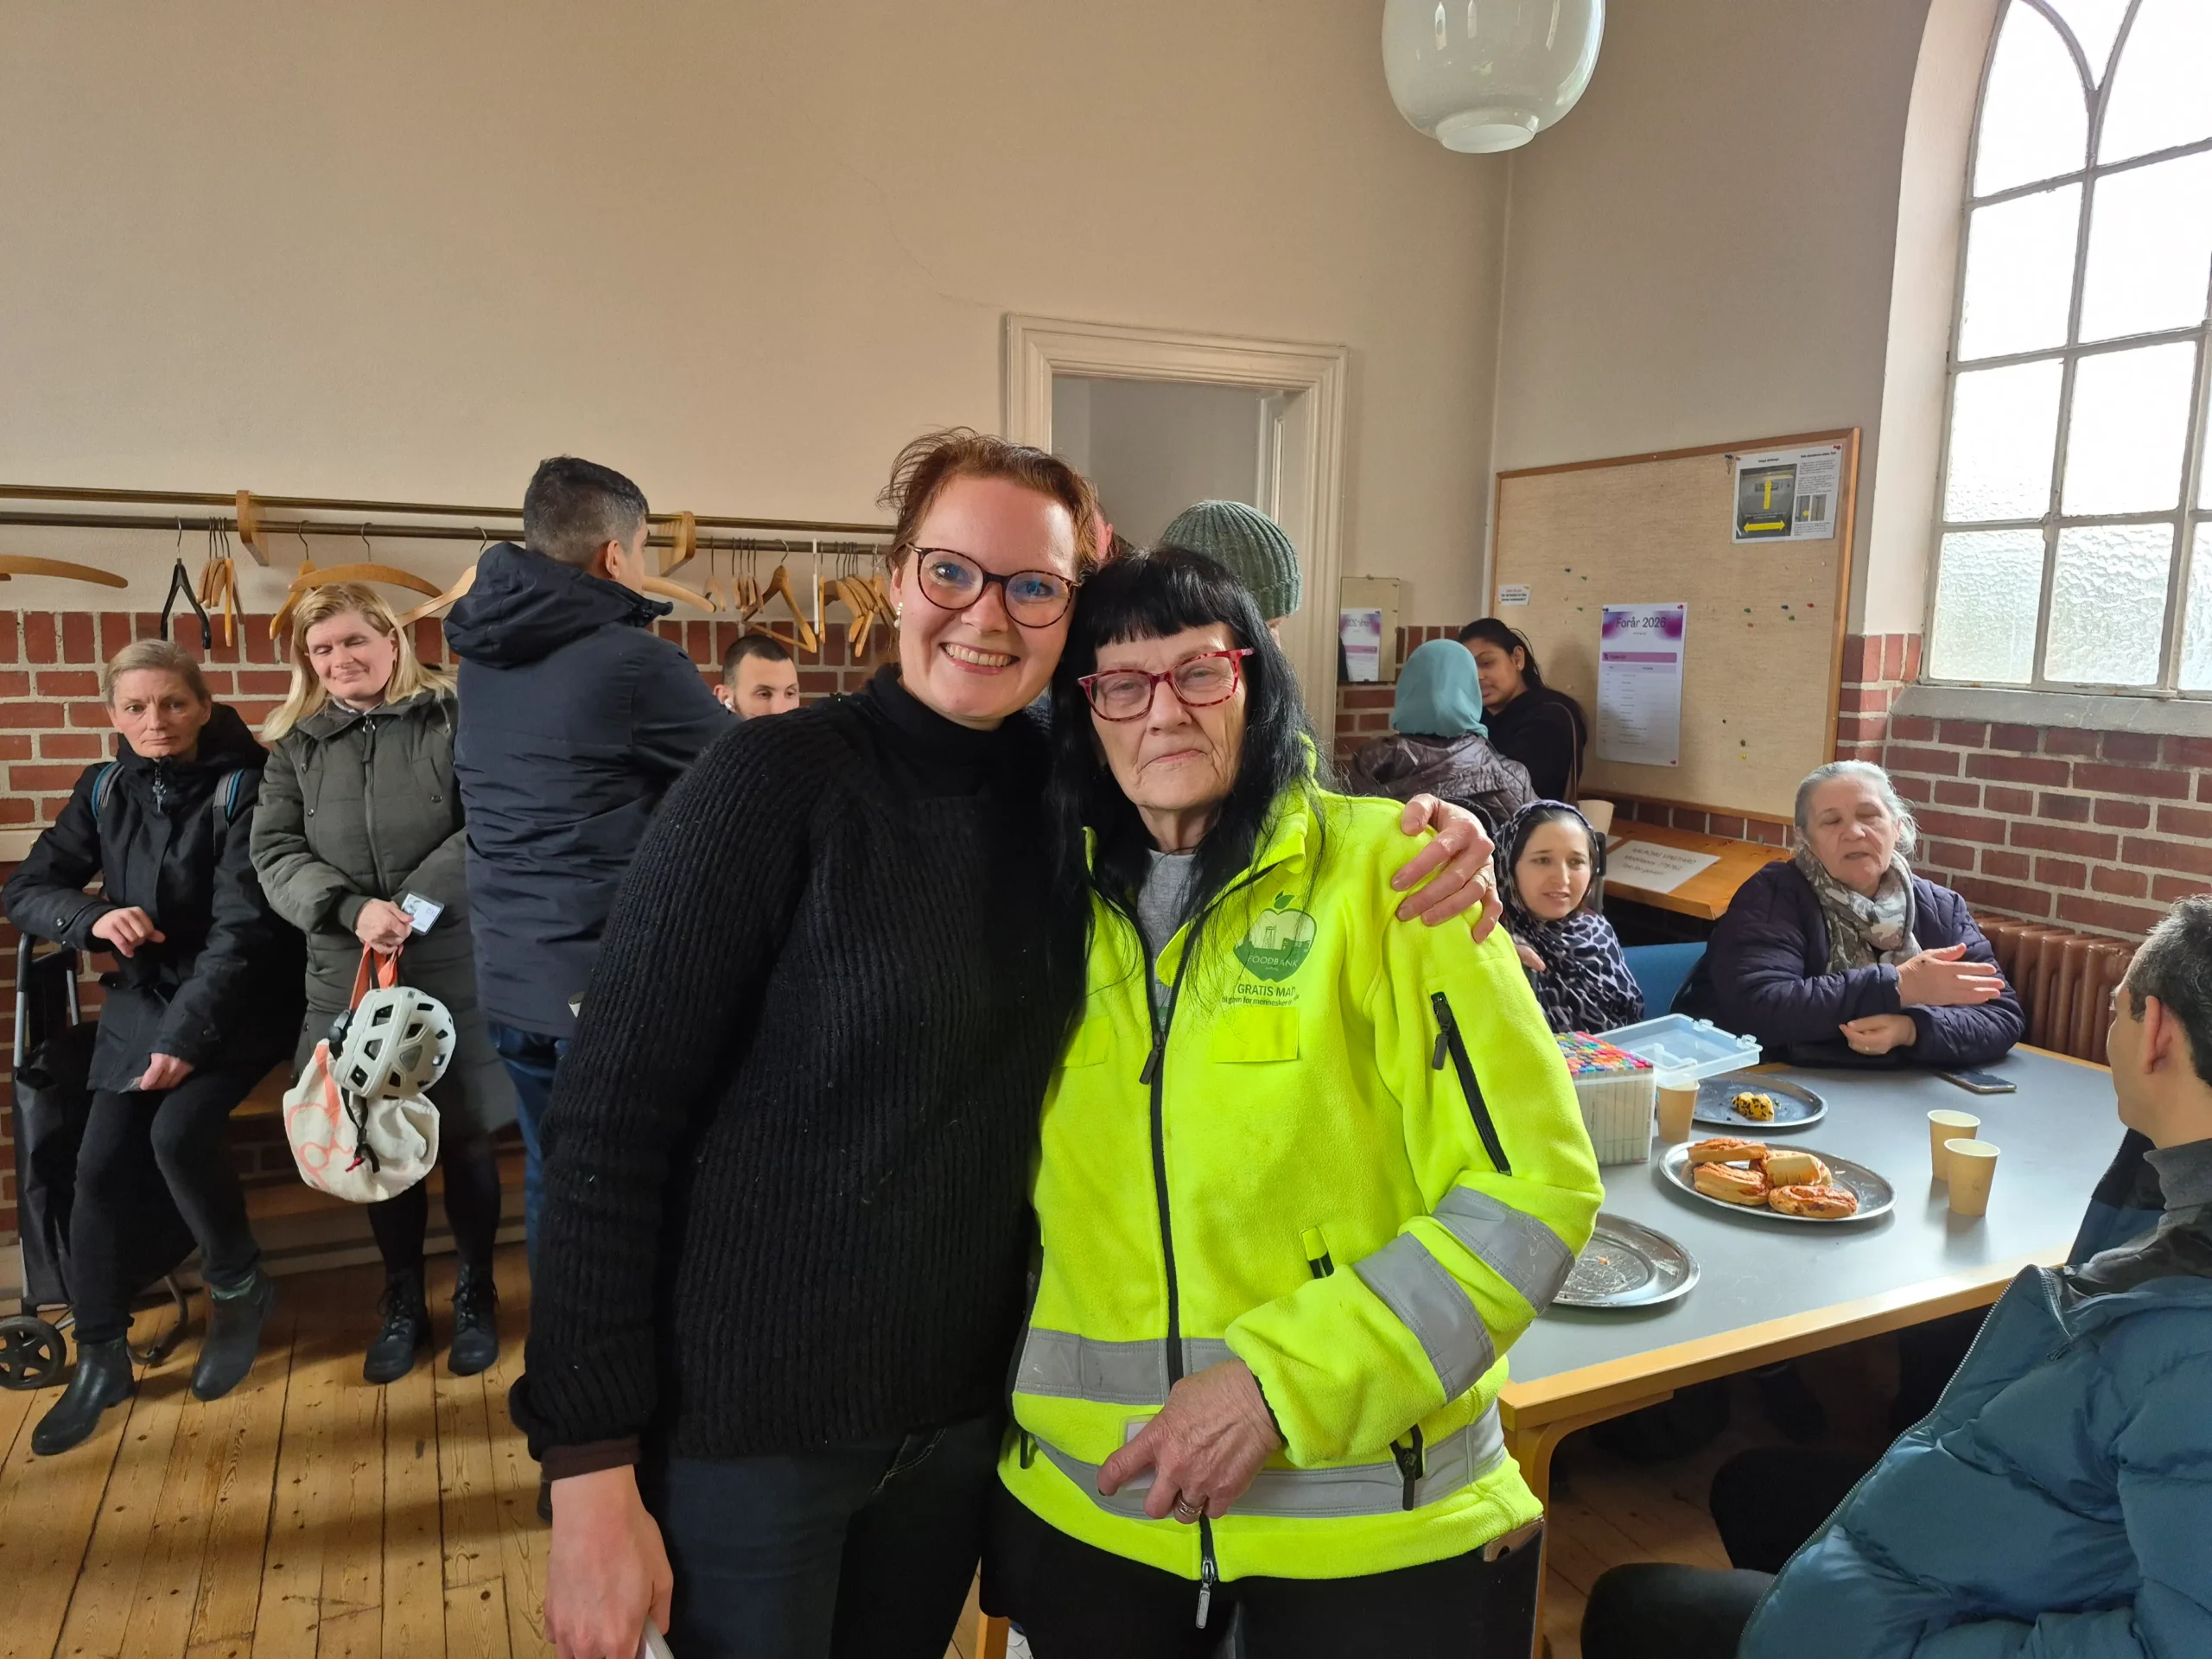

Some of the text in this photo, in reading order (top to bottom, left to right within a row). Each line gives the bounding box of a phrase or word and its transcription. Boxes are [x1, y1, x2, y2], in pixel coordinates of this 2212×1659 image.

[1616, 616, 1667, 628] Forår 2026
[1248, 955, 1299, 967] FOODBANK
[1237, 983, 1274, 996] GRATIS
